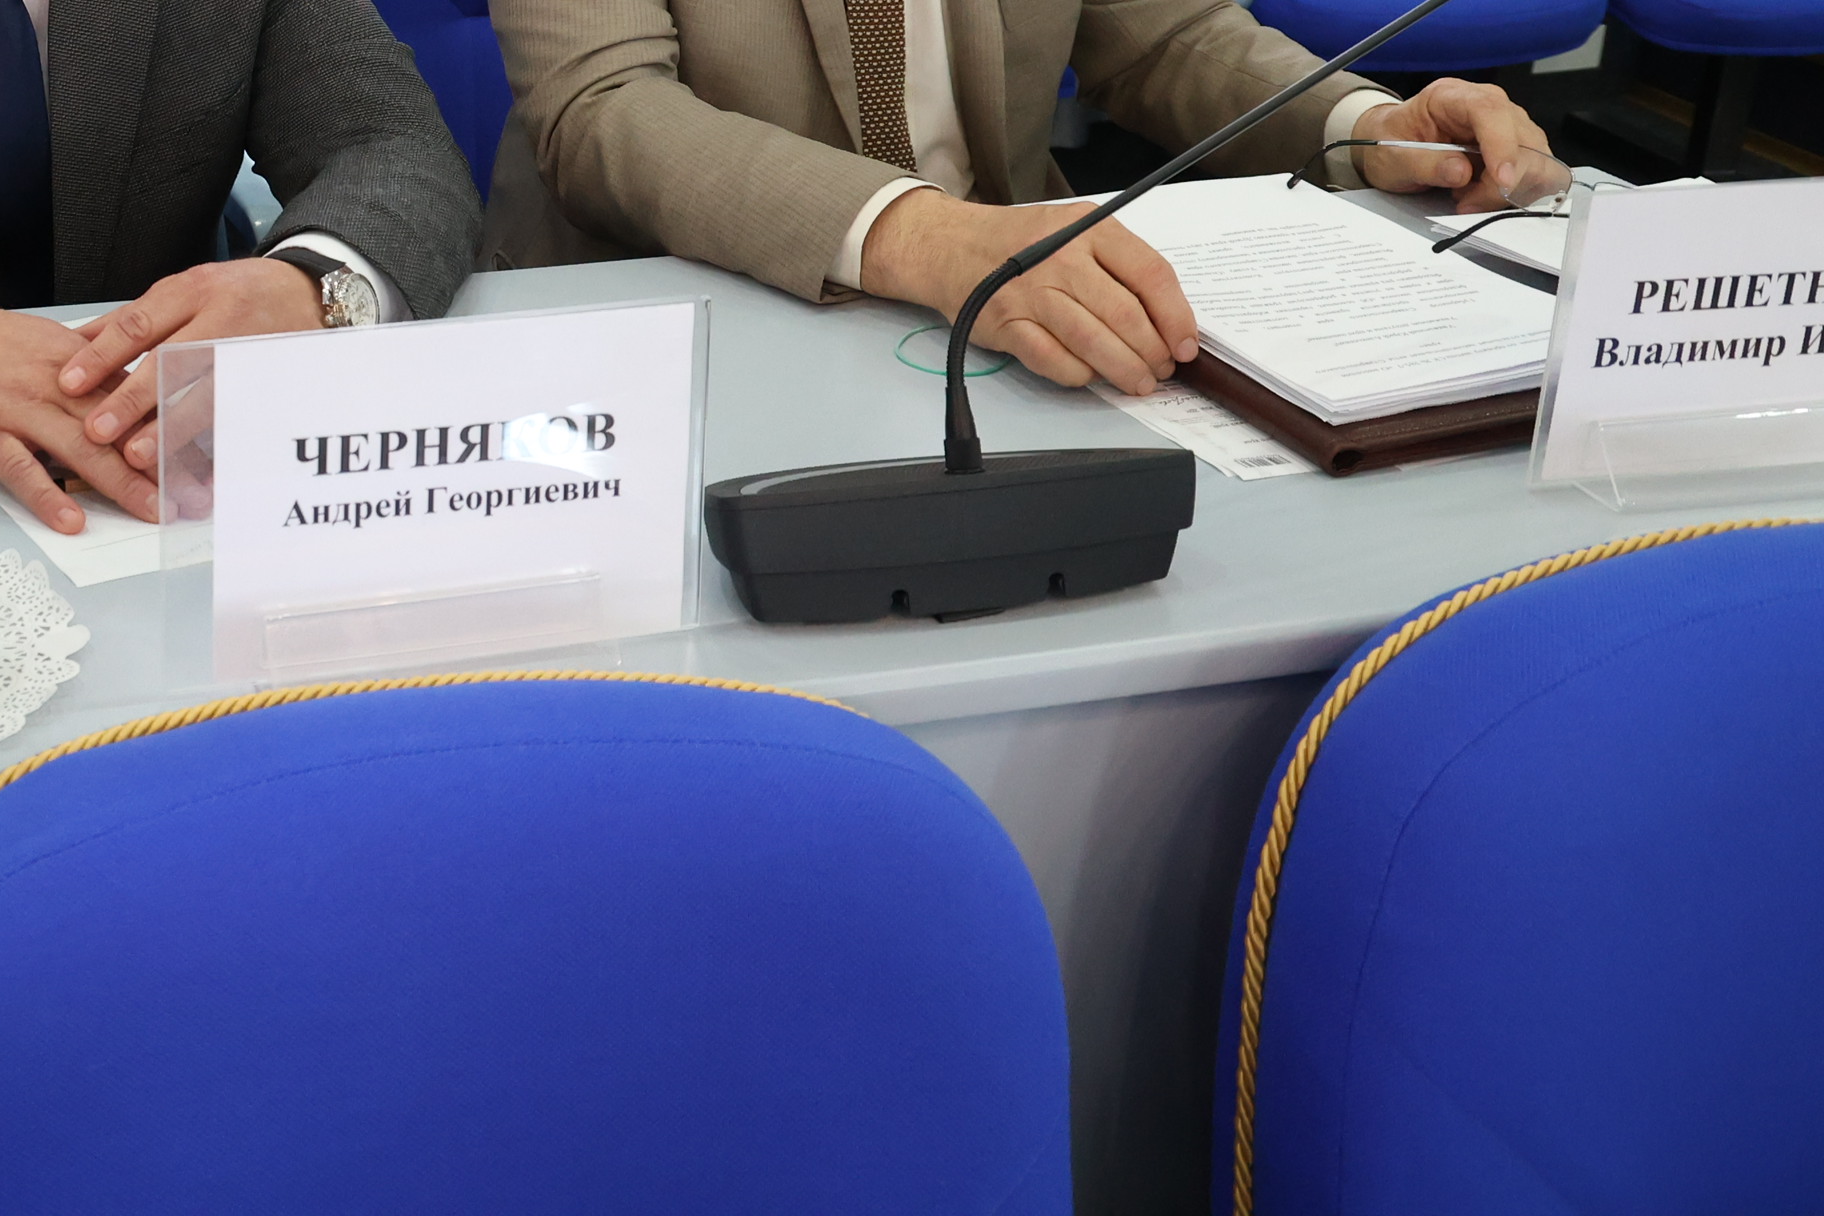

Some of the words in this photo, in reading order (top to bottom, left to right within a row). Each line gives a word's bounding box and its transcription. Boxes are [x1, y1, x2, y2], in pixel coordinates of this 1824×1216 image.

[1592, 335, 1787, 368] Владимир
[283, 491, 412, 529] Андрей
[425, 478, 621, 517] Георгиевич
